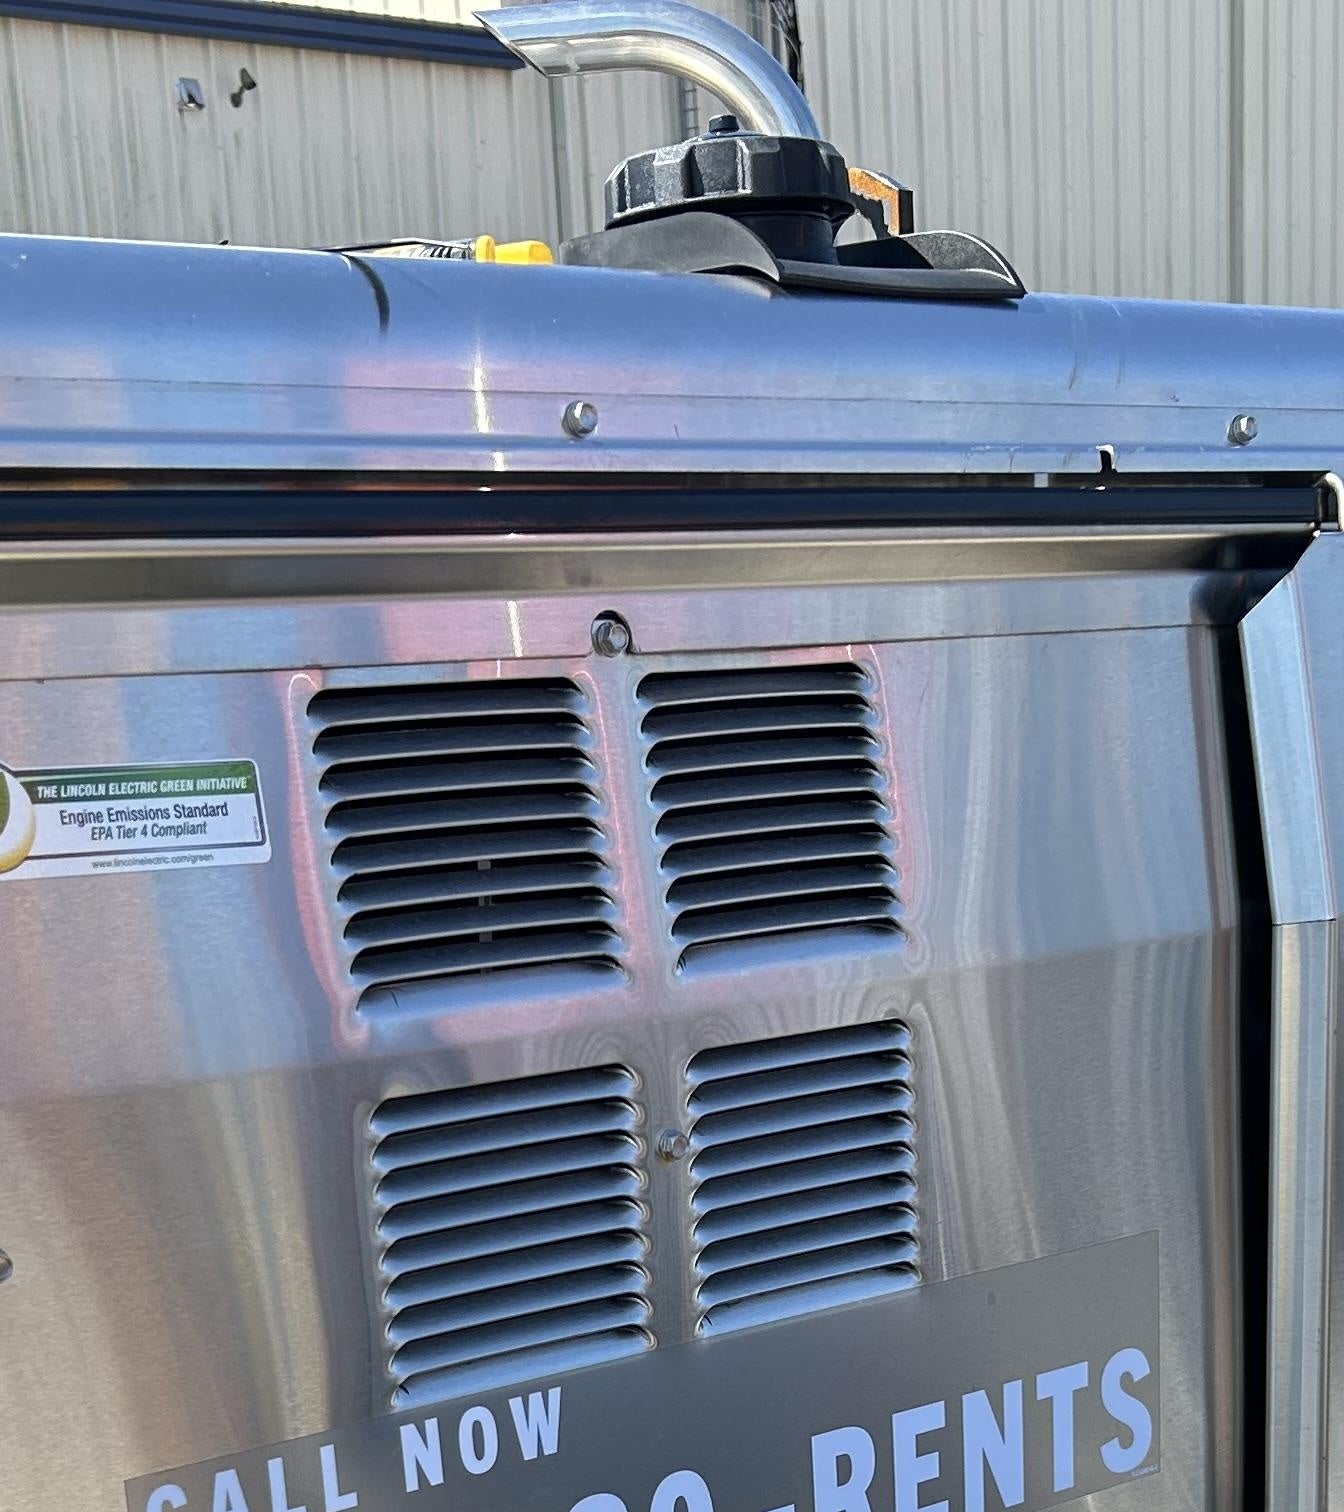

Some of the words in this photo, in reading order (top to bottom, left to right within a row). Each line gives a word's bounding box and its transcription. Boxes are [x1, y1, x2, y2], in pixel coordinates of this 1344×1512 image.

[38, 785, 58, 798] THE
[61, 784, 105, 798] LINCOLN
[109, 782, 157, 795] ELECTRIC
[161, 779, 193, 793] GREEN
[196, 777, 247, 791] INITIATIVE
[60, 809, 104, 826] Engine
[107, 806, 170, 824] Emissions
[174, 802, 228, 819] Standard
[91, 826, 113, 841] EPA
[116, 825, 138, 840] Tier
[141, 825, 148, 838] 4
[151, 821, 207, 840] Compliant
[400, 1386, 563, 1492] NOW
